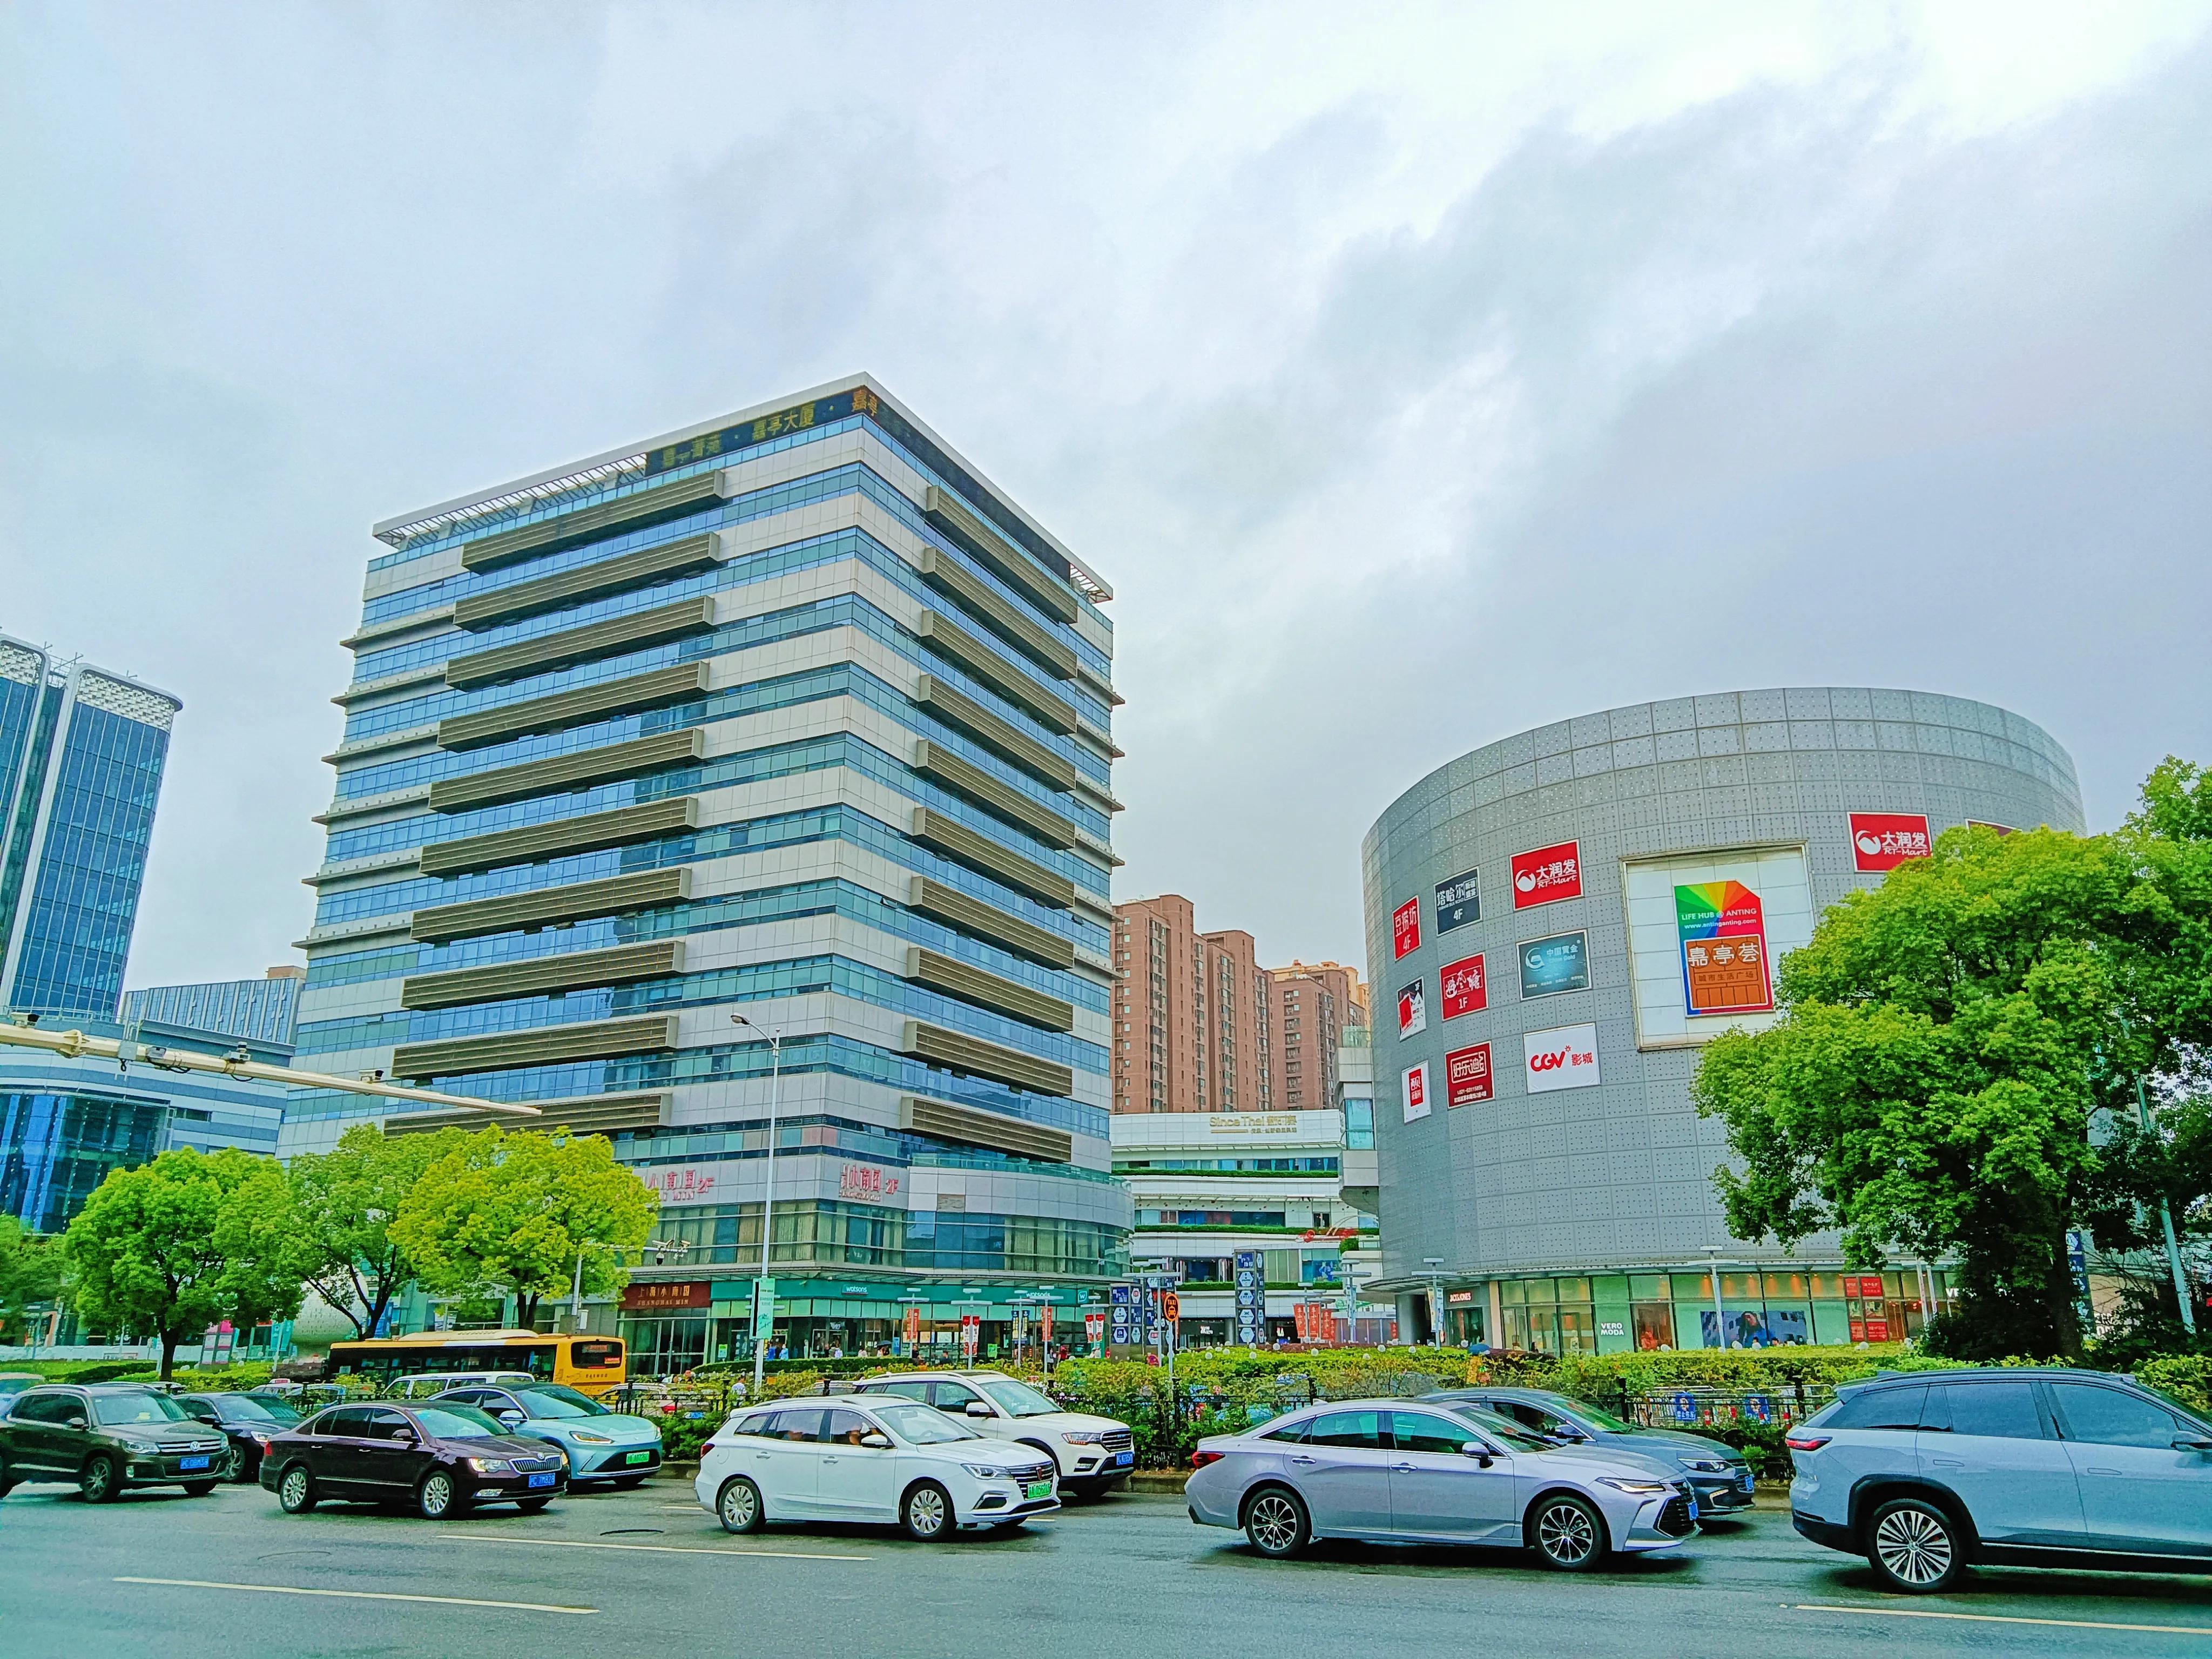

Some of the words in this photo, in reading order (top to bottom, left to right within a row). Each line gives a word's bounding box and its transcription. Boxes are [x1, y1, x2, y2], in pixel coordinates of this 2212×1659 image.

[1880, 831, 1927, 847] 大润发
[1883, 847, 1928, 856] RT-Mart
[1536, 859, 1577, 881] 大润发
[1537, 875, 1577, 889] RT-Mart
[1437, 884, 1464, 906] 塔哈尔
[1453, 908, 1463, 921] 4F
[1726, 908, 1757, 917] ANTING
[1395, 905, 1417, 938] 豆捞坊
[1684, 918, 1756, 929] www.antinganting.com
[1403, 934, 1411, 950] 4F
[1546, 944, 1579, 956] 中国黄金
[1688, 942, 1759, 967] 嘉亭荟
[1698, 970, 1754, 982] 城市生活广场
[1459, 996, 1468, 1009] 1F
[1453, 1054, 1485, 1078] 好乐迪
[1530, 1051, 1566, 1072] CGV
[1571, 1052, 1593, 1066] 影城
[697, 1177, 714, 1193] 2F
[886, 1179, 899, 1195] 2F
